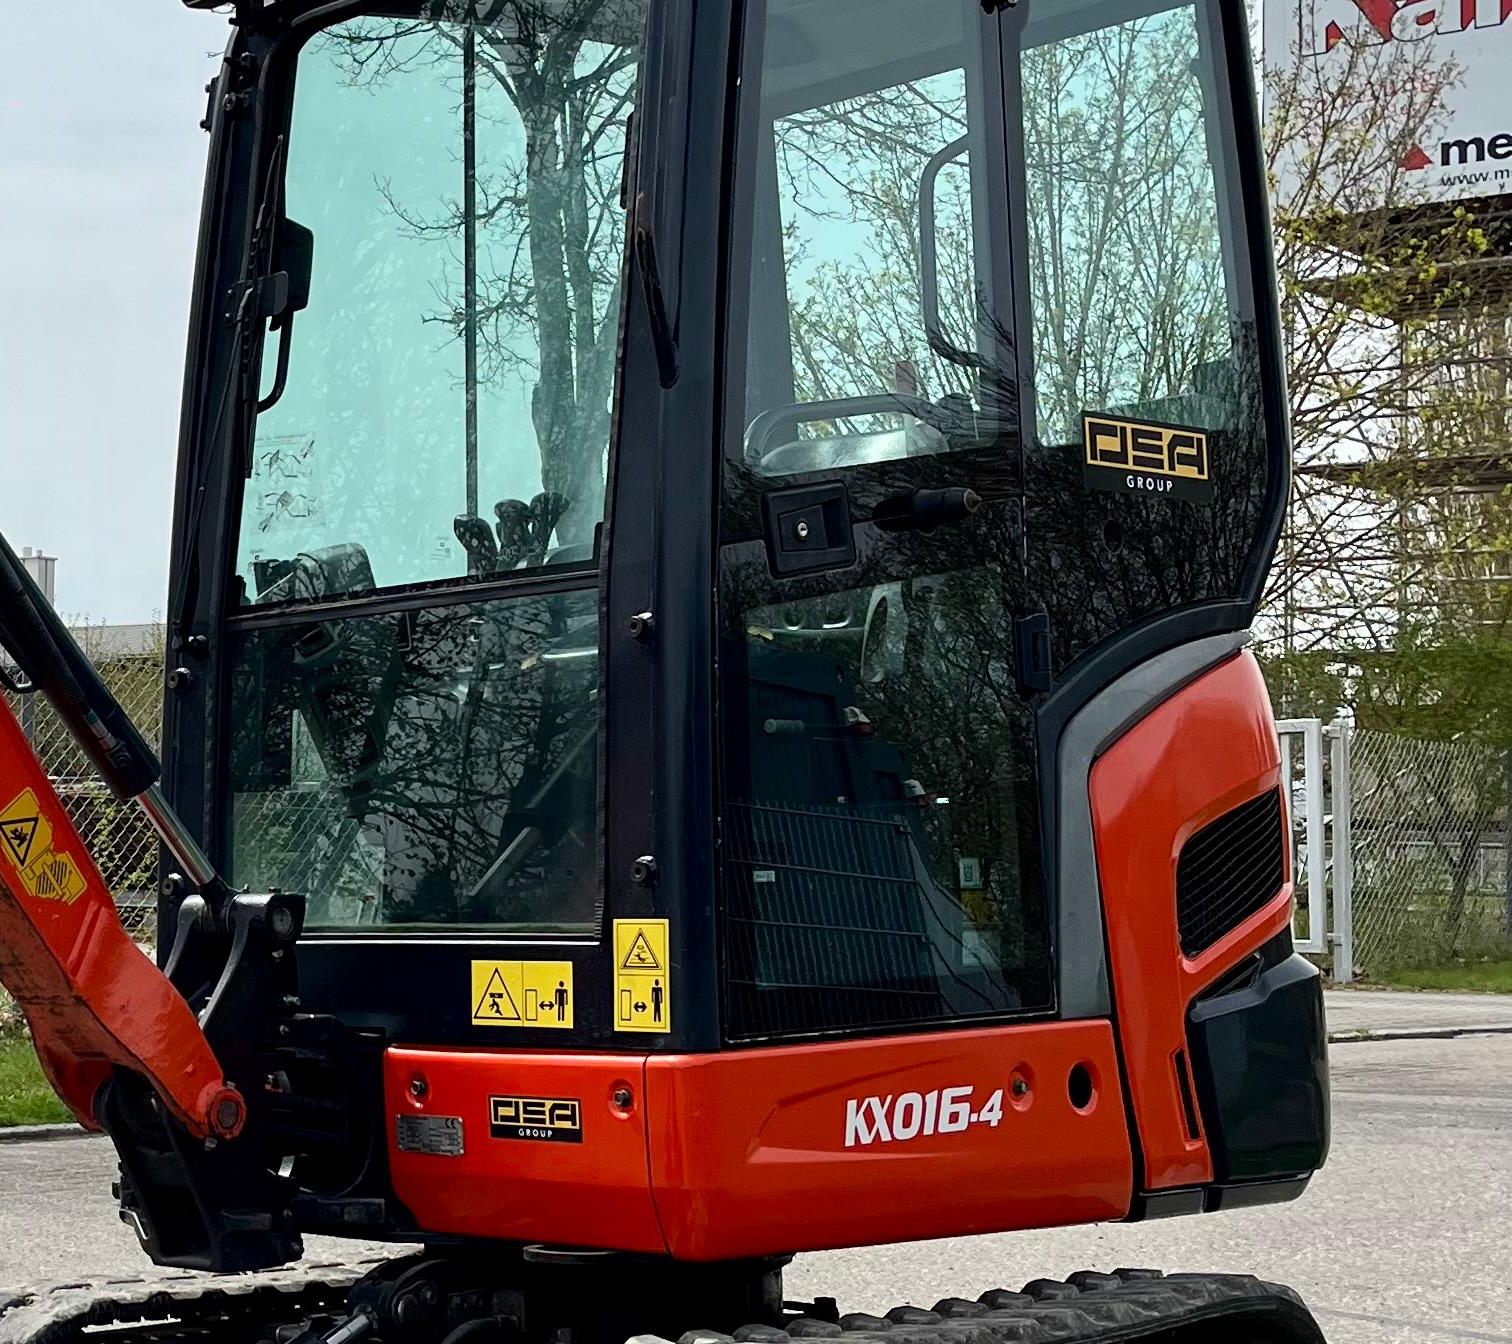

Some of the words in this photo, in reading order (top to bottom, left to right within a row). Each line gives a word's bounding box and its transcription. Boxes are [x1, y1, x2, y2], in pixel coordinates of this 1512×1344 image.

[1126, 475, 1173, 492] GROUP
[844, 1085, 1004, 1147] KX016-4
[518, 1128, 553, 1138] GROUP
